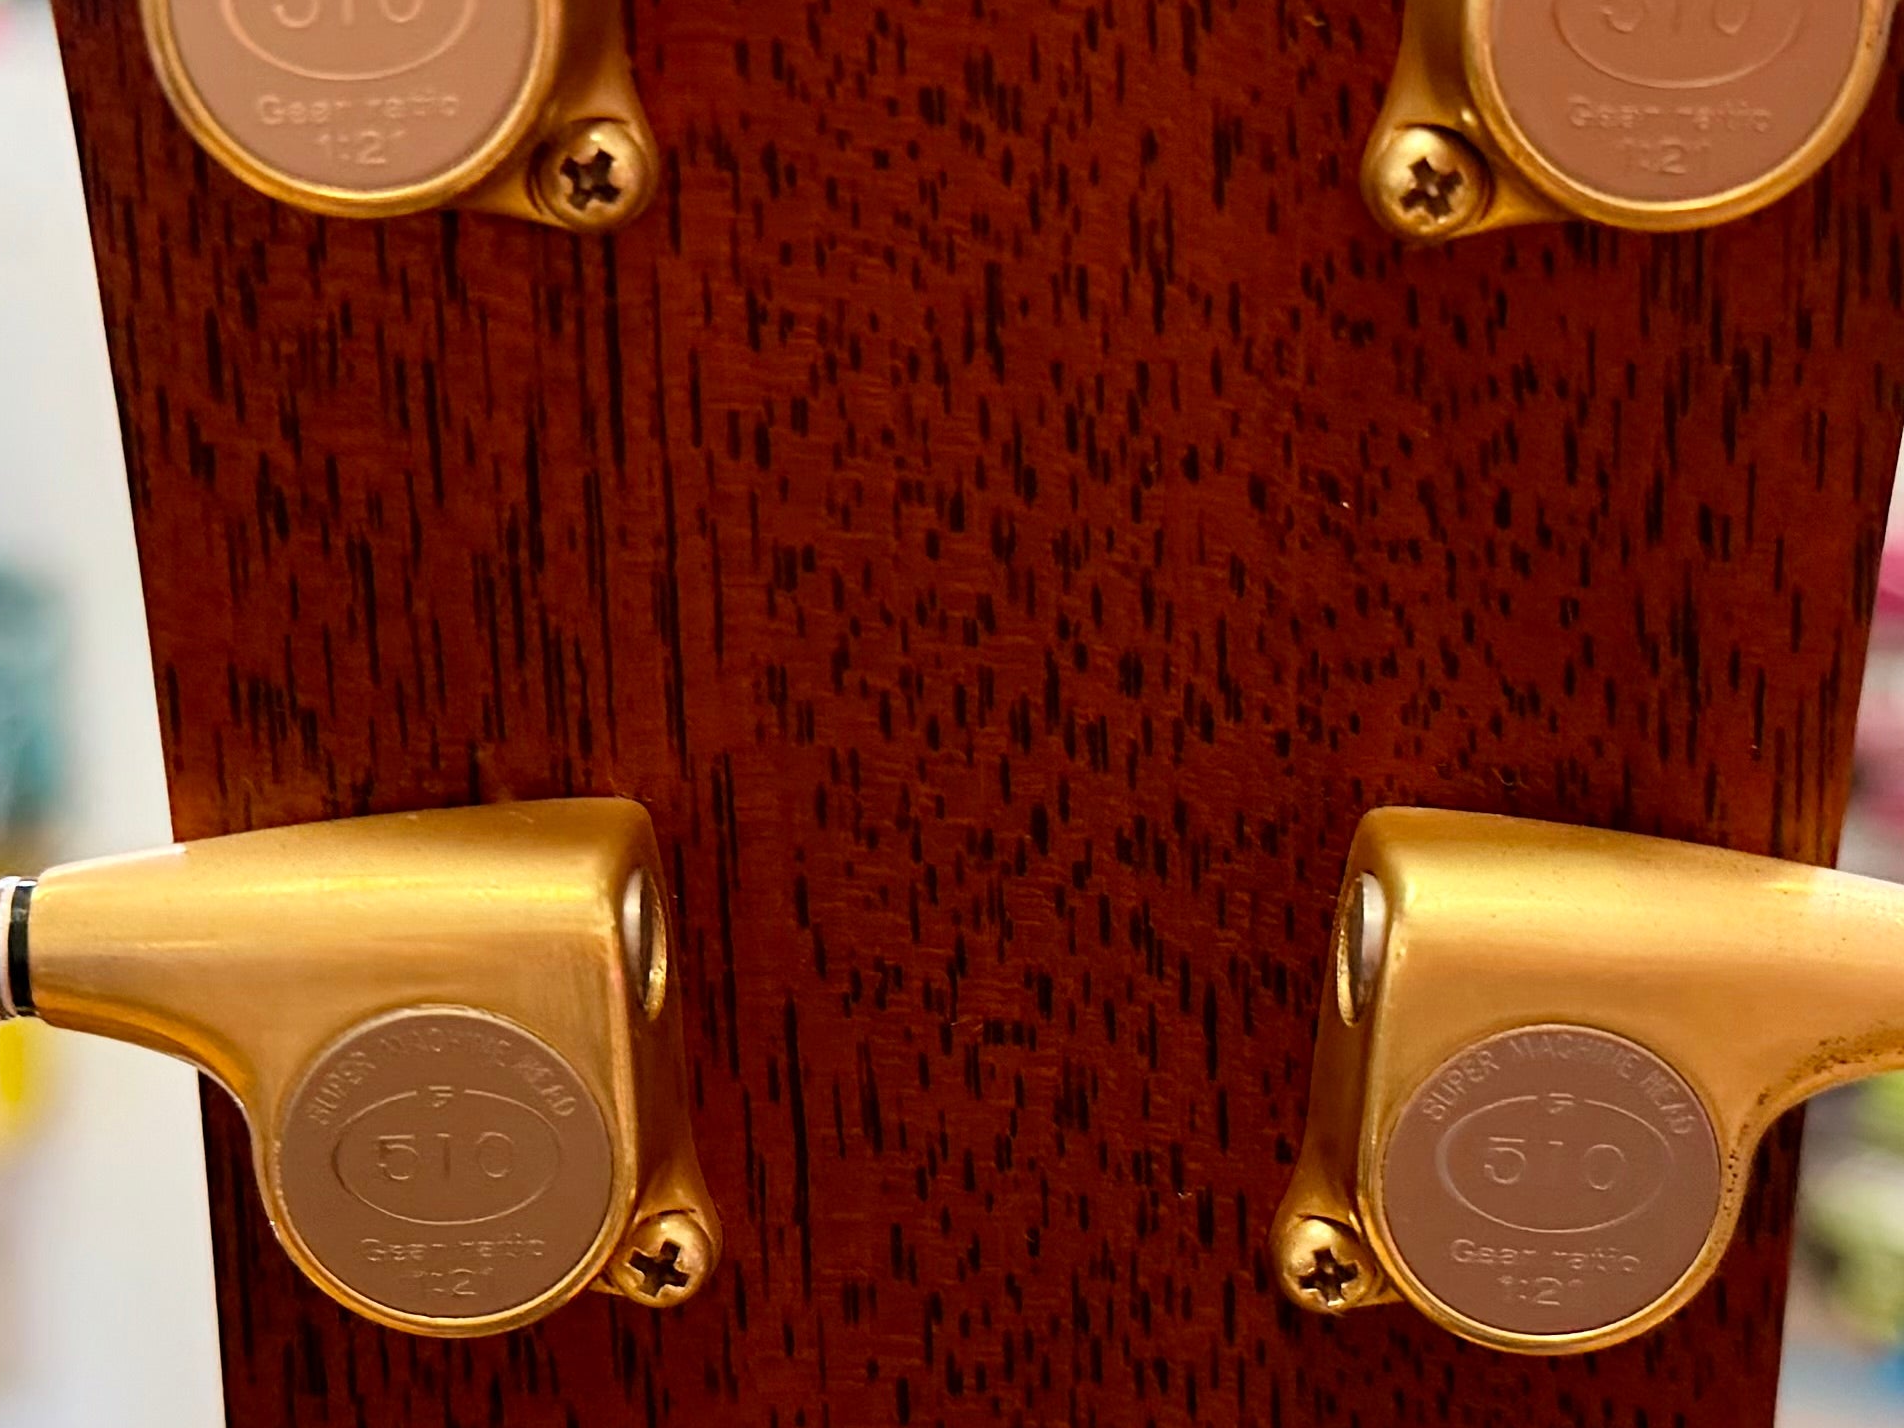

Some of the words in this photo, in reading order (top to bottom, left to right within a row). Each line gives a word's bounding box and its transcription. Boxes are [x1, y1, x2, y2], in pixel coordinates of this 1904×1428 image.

[1421, 1049, 1500, 1122] SUPER
[1640, 1068, 1696, 1136] HEAD
[374, 1131, 515, 1182] 510
[1484, 1136, 1626, 1191] 510
